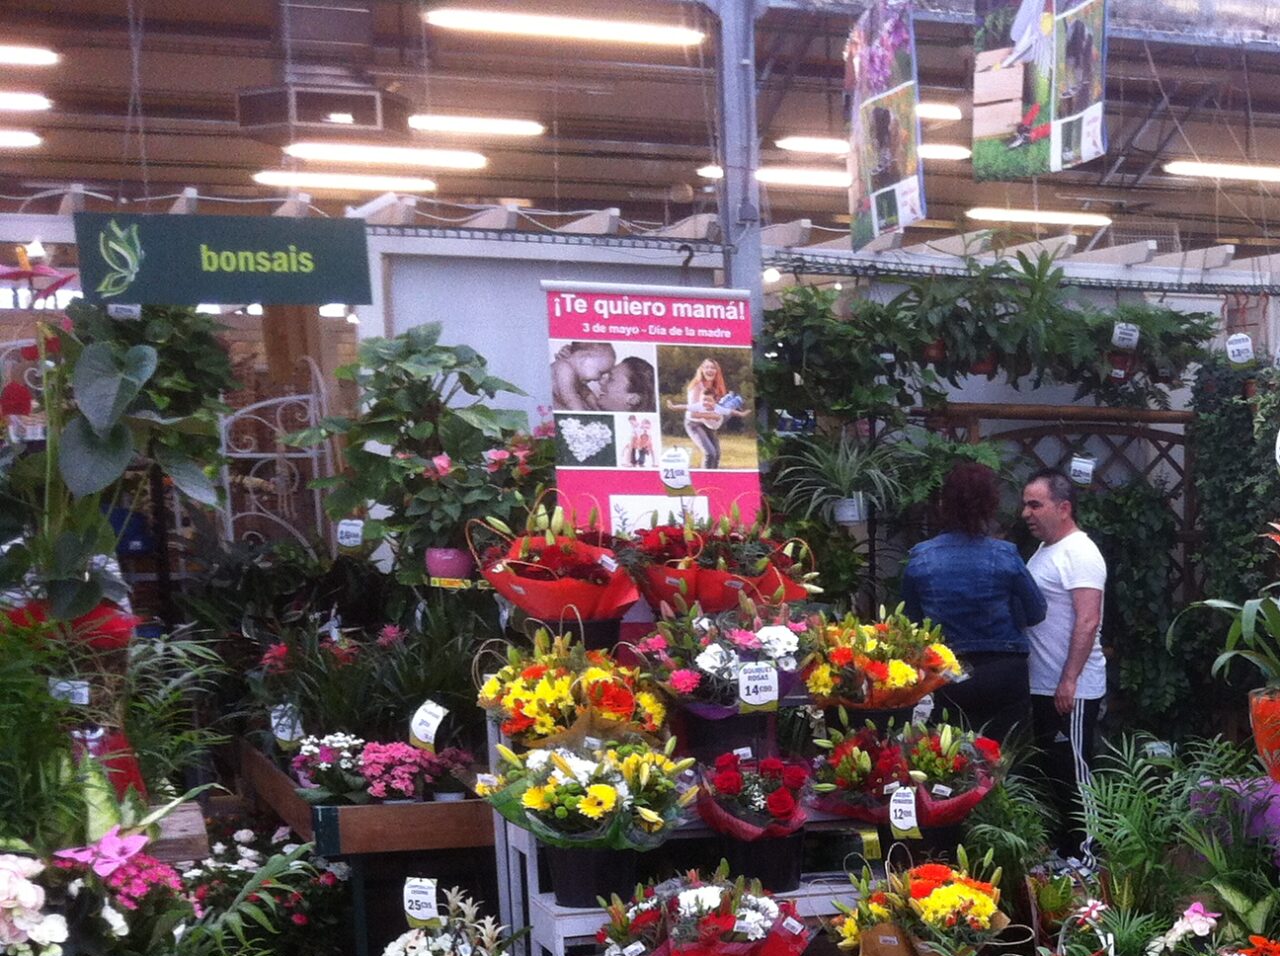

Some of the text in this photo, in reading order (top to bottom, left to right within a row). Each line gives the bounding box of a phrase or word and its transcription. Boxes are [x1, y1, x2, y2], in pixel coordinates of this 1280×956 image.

[200, 243, 315, 273] bonsais
[554, 293, 745, 320] ¡Te quiero mamá!
[582, 323, 591, 333] 3
[592, 323, 607, 333] de
[609, 325, 640, 337] mayo
[648, 325, 668, 336] Día
[669, 326, 684, 336] de
[685, 326, 696, 337] la
[698, 327, 732, 338] madre
